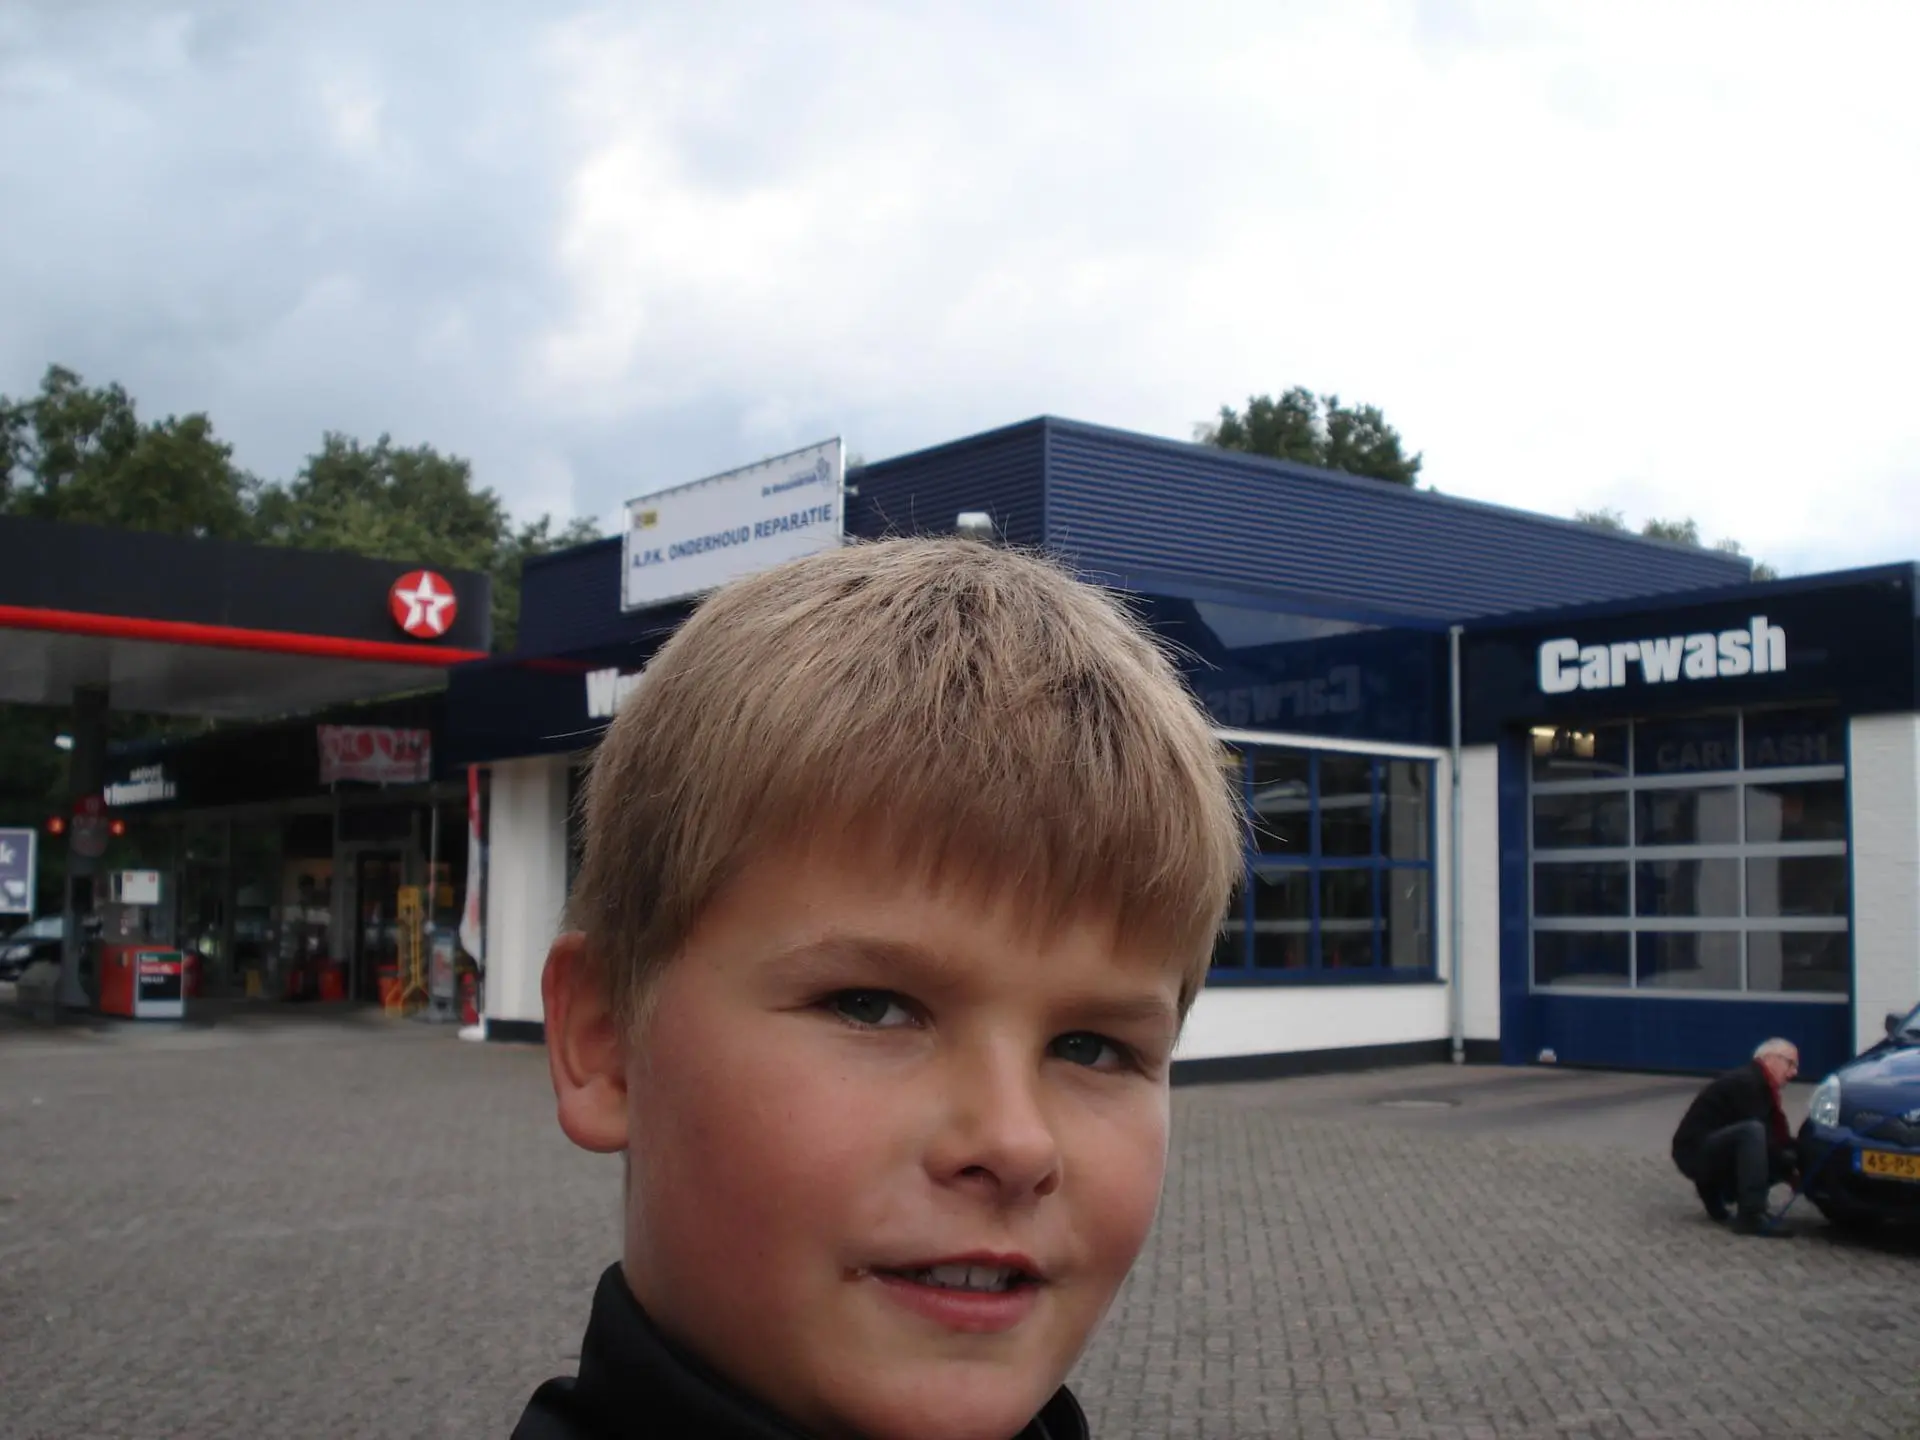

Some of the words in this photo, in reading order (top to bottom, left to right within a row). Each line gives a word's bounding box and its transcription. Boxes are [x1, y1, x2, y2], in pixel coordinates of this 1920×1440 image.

[667, 525, 751, 560] ONDERHOUD
[753, 503, 832, 540] REPARATIE
[1539, 615, 1786, 693] Carwash
[1656, 732, 1828, 771] CARASH
